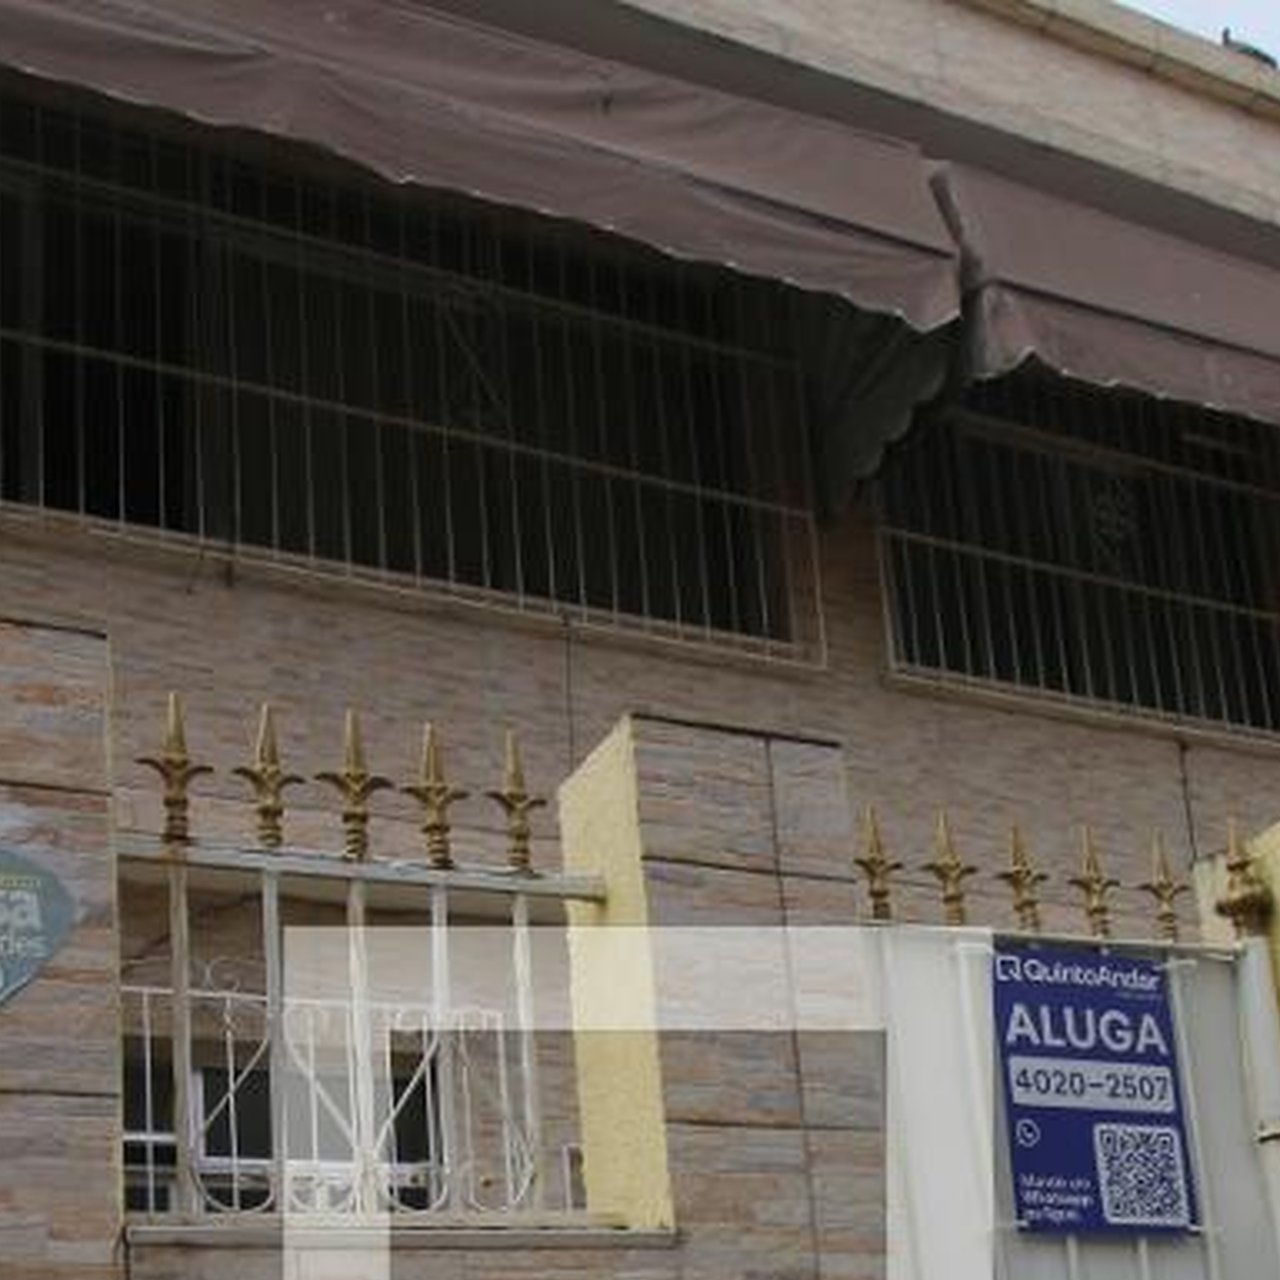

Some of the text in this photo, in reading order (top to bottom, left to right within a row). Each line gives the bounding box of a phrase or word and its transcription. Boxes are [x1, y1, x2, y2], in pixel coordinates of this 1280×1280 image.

[1024, 960, 1160, 989] QuintoAndar
[1007, 1003, 1167, 1055] ALUGA
[1015, 1068, 1169, 1101] 4020-2507
